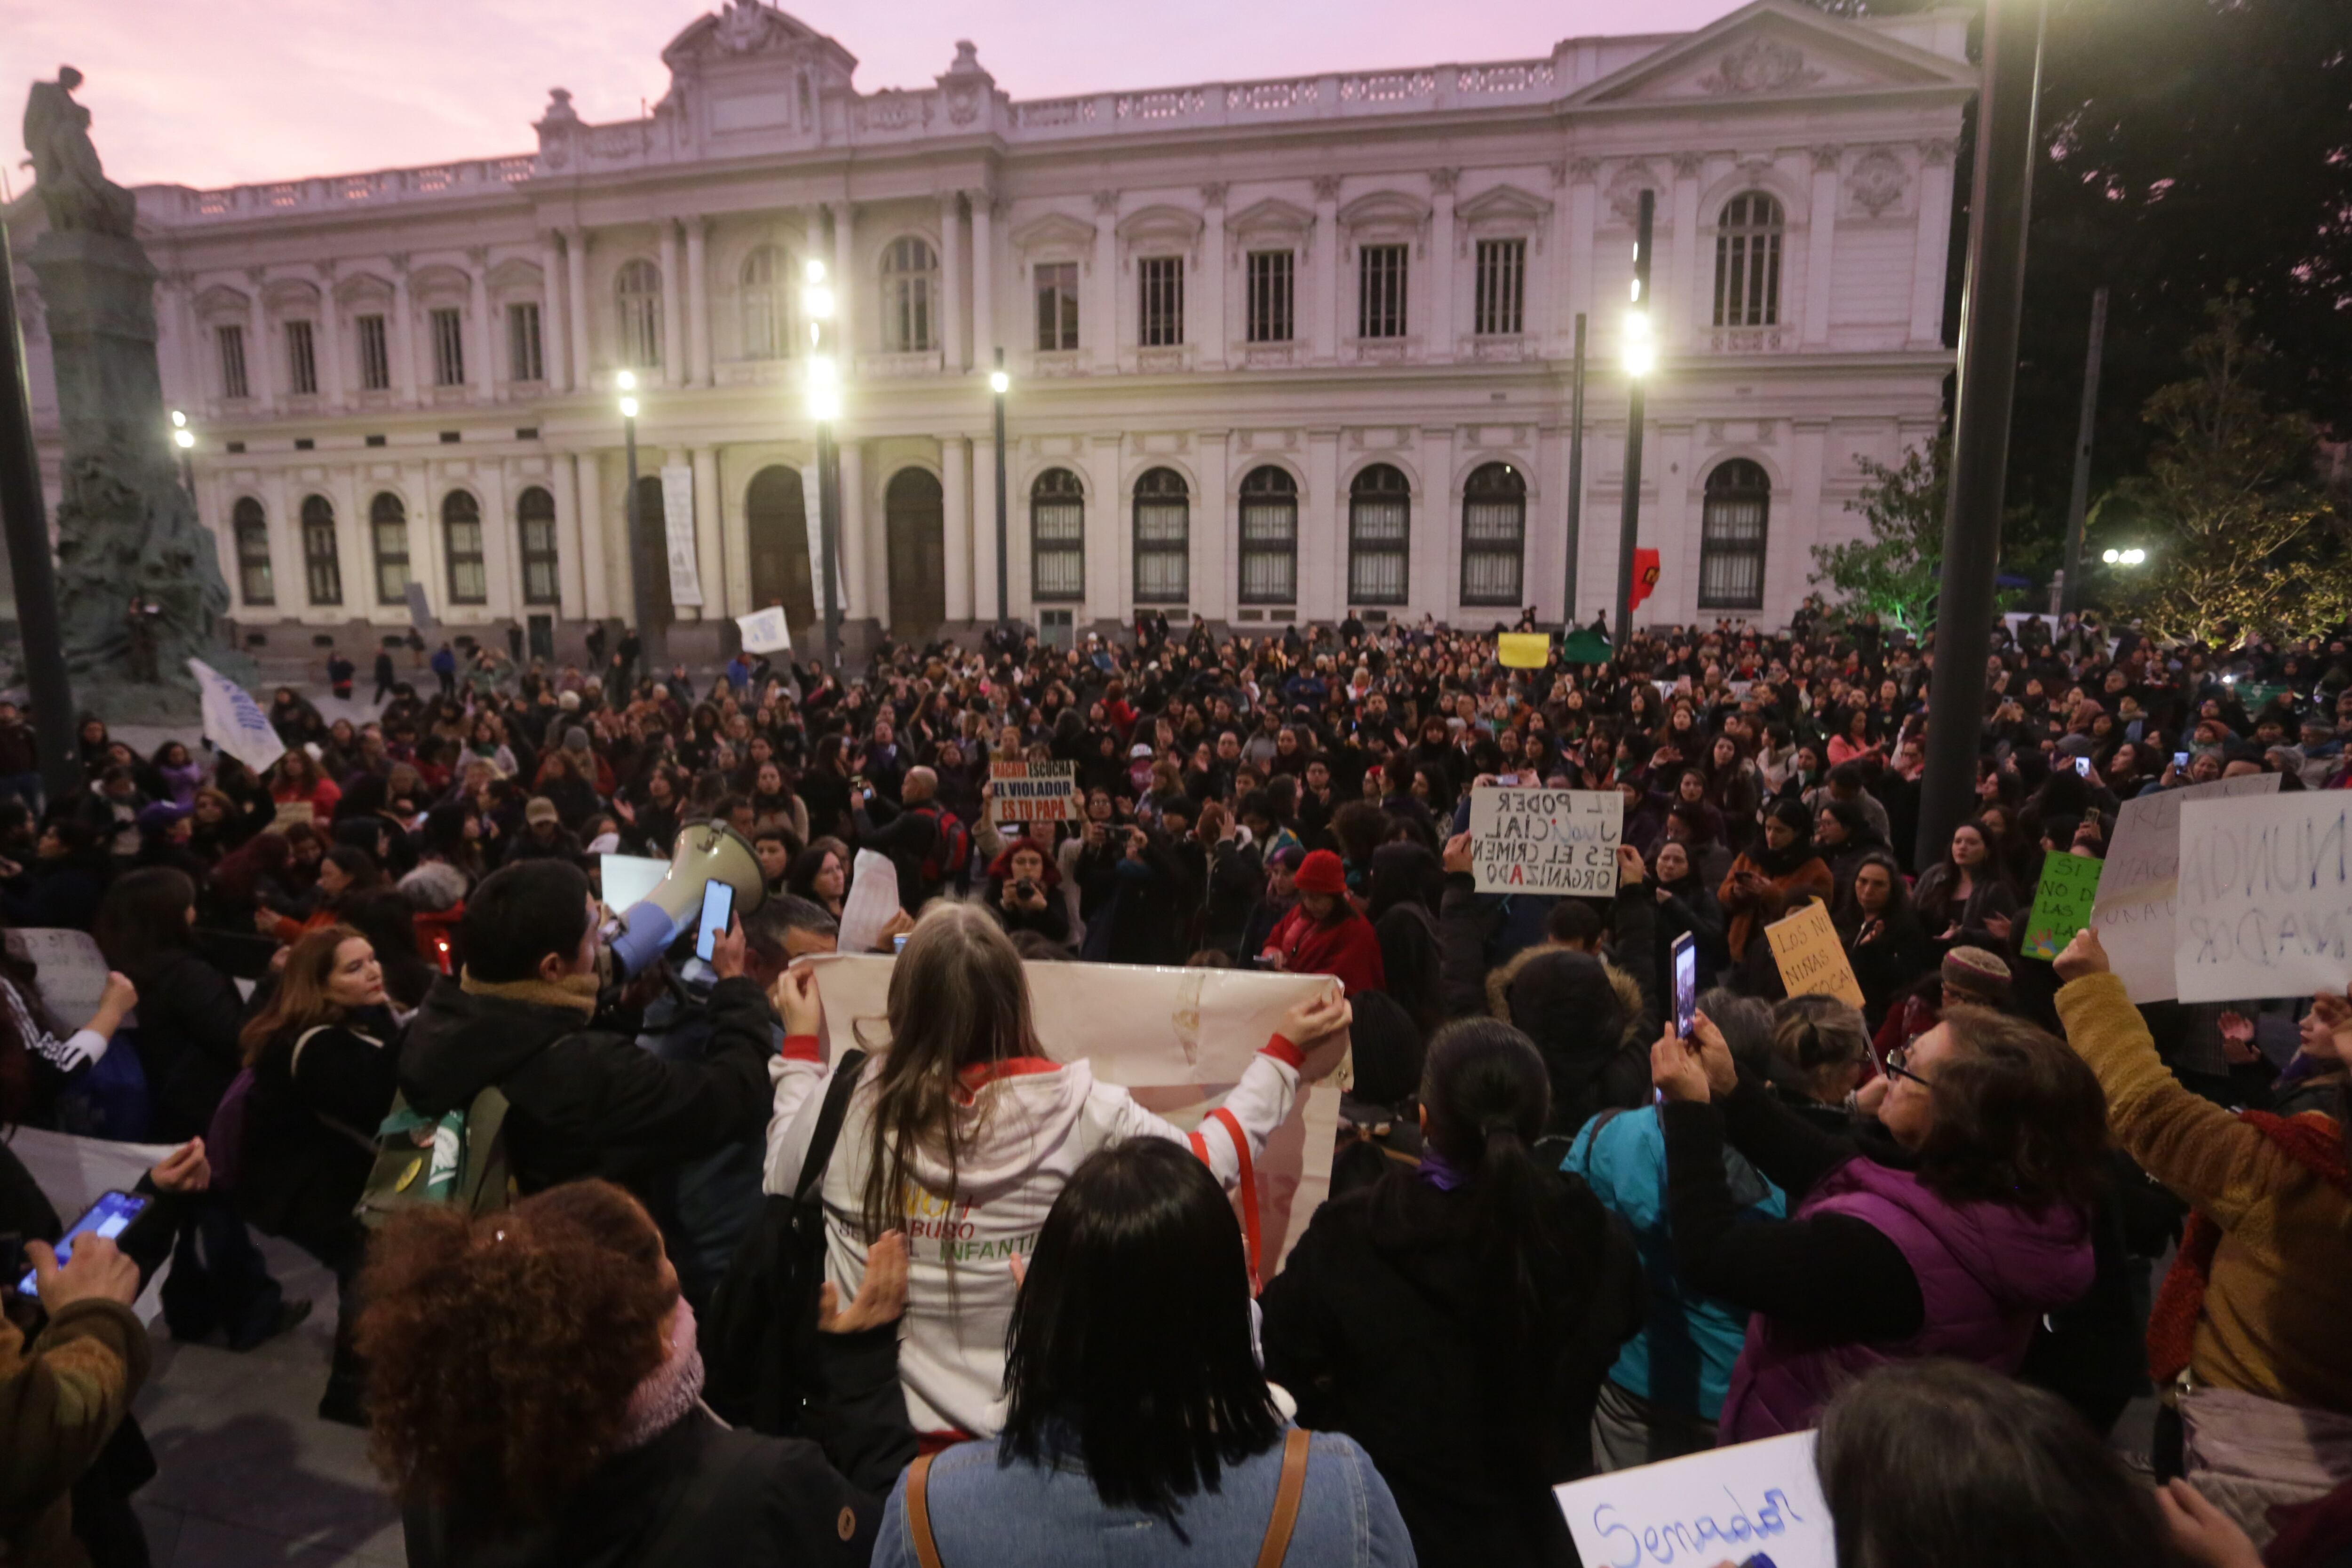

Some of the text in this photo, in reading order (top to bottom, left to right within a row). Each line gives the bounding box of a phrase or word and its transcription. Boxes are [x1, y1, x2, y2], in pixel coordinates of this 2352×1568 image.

[993, 760, 1072, 777] MACAYA ESCUCHA
[993, 780, 1071, 797] EL VIOLADOR
[1001, 800, 1015, 820] ES
[1018, 800, 1033, 820] TU
[2054, 858, 2082, 877] SI
[2040, 880, 2068, 897] NO
[2042, 900, 2074, 917] LAS
[1777, 924, 1808, 954] LOS
[1810, 913, 1831, 937] NI
[910, 1219, 975, 1241] BUSO
[940, 1231, 1037, 1262] INFANTI
[1593, 1484, 1804, 1568] Senador
